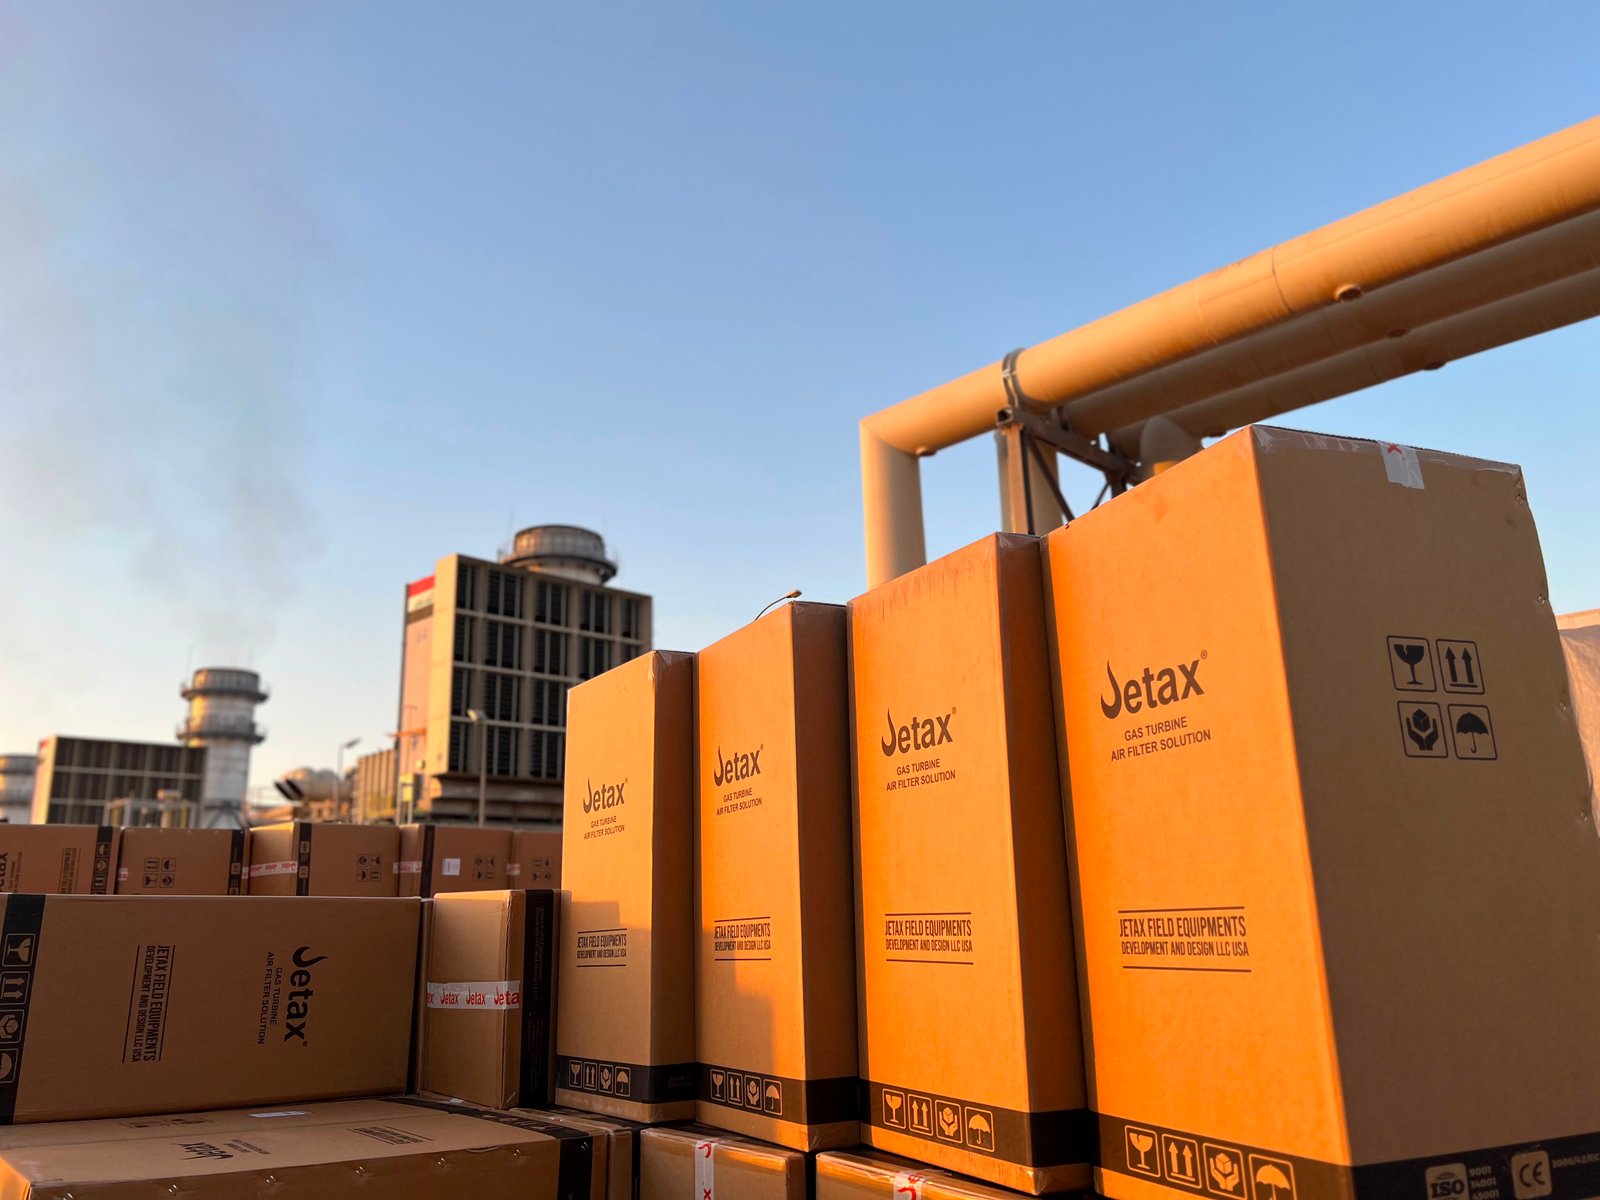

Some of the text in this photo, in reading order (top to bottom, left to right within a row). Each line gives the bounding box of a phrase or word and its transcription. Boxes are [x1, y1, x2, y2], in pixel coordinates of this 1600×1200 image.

[1101, 658, 1205, 720] Jetax
[881, 707, 953, 757] Jetax
[1124, 716, 1188, 741] GAS TURBINE
[1111, 729, 1211, 762] AIR FILTER SOLUTION
[713, 745, 761, 787] Jetax
[896, 758, 941, 776] GAS TURBINE
[886, 769, 956, 791] AIR FILTER SOLUTION
[583, 777, 625, 814] Jetax
[716, 796, 763, 816] AIR FILTER SOLUTION
[723, 787, 753, 803] GAS TURBINE
[740, 922, 770, 939] EQUIPMENTS
[885, 919, 972, 938] JETAX FIELD EQUIPMENTS
[1119, 915, 1247, 939] JETAX FIELD EQUIPMENTS
[885, 938, 973, 953] DEVELOPMENT AND DESIGN LLC USA
[1121, 941, 1250, 957] DEVELOPMENT AND DESIGN LLC USA
[141, 945, 156, 992] DEVELOPMENT
[138, 994, 149, 1008] AND
[143, 945, 170, 1062] JETAX FIELD EQUIPMENTS
[257, 951, 274, 1045] AIR FILTER SOLUTION
[269, 967, 283, 1026] GAS TURBINE
[283, 946, 328, 1042] Jetax
[441, 987, 460, 1005] Jetax
[466, 986, 486, 1005] Jetax
[136, 1009, 147, 1034] DESIGN
[1469, 1165, 1492, 1177] 9001
[1430, 1178, 1465, 1199] ISO
[1470, 1178, 1497, 1189] 14001
